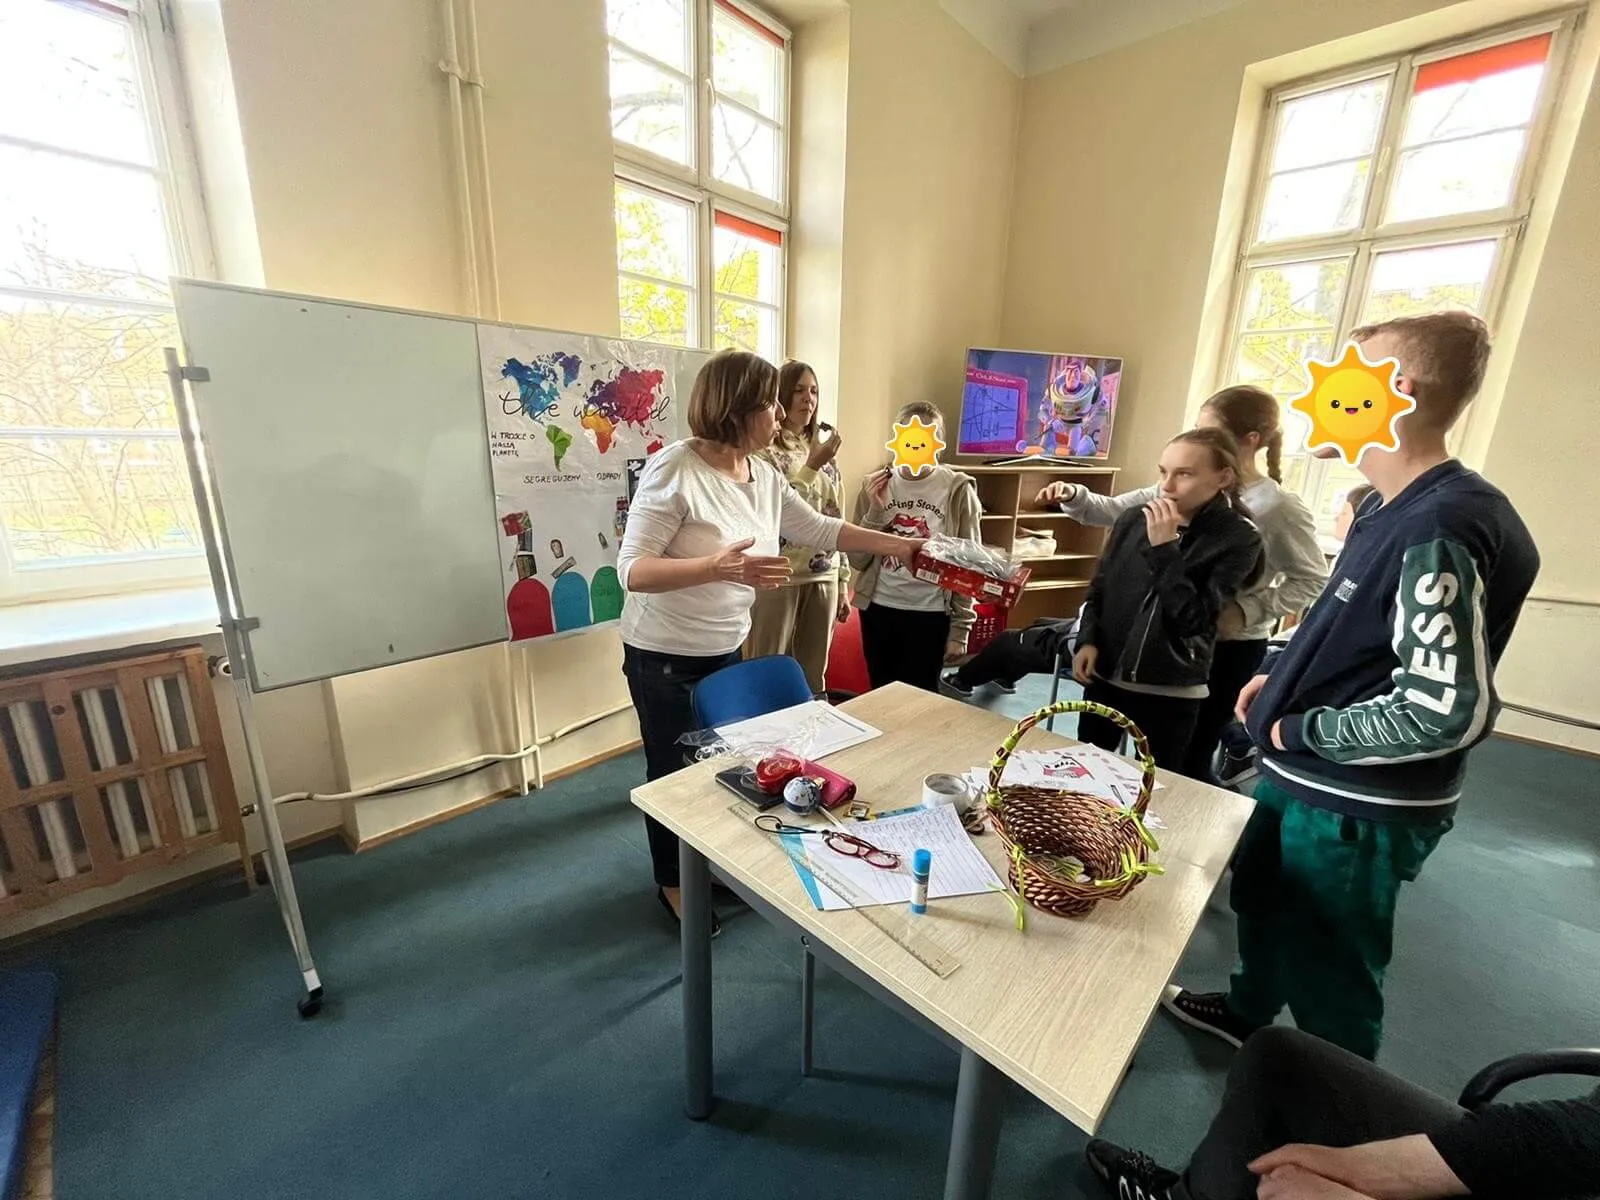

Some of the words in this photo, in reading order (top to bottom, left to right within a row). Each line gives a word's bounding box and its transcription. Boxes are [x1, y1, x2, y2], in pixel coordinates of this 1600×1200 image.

[499, 390, 560, 419] the
[573, 395, 670, 422] world
[523, 474, 581, 484] SEGREGUJEMY
